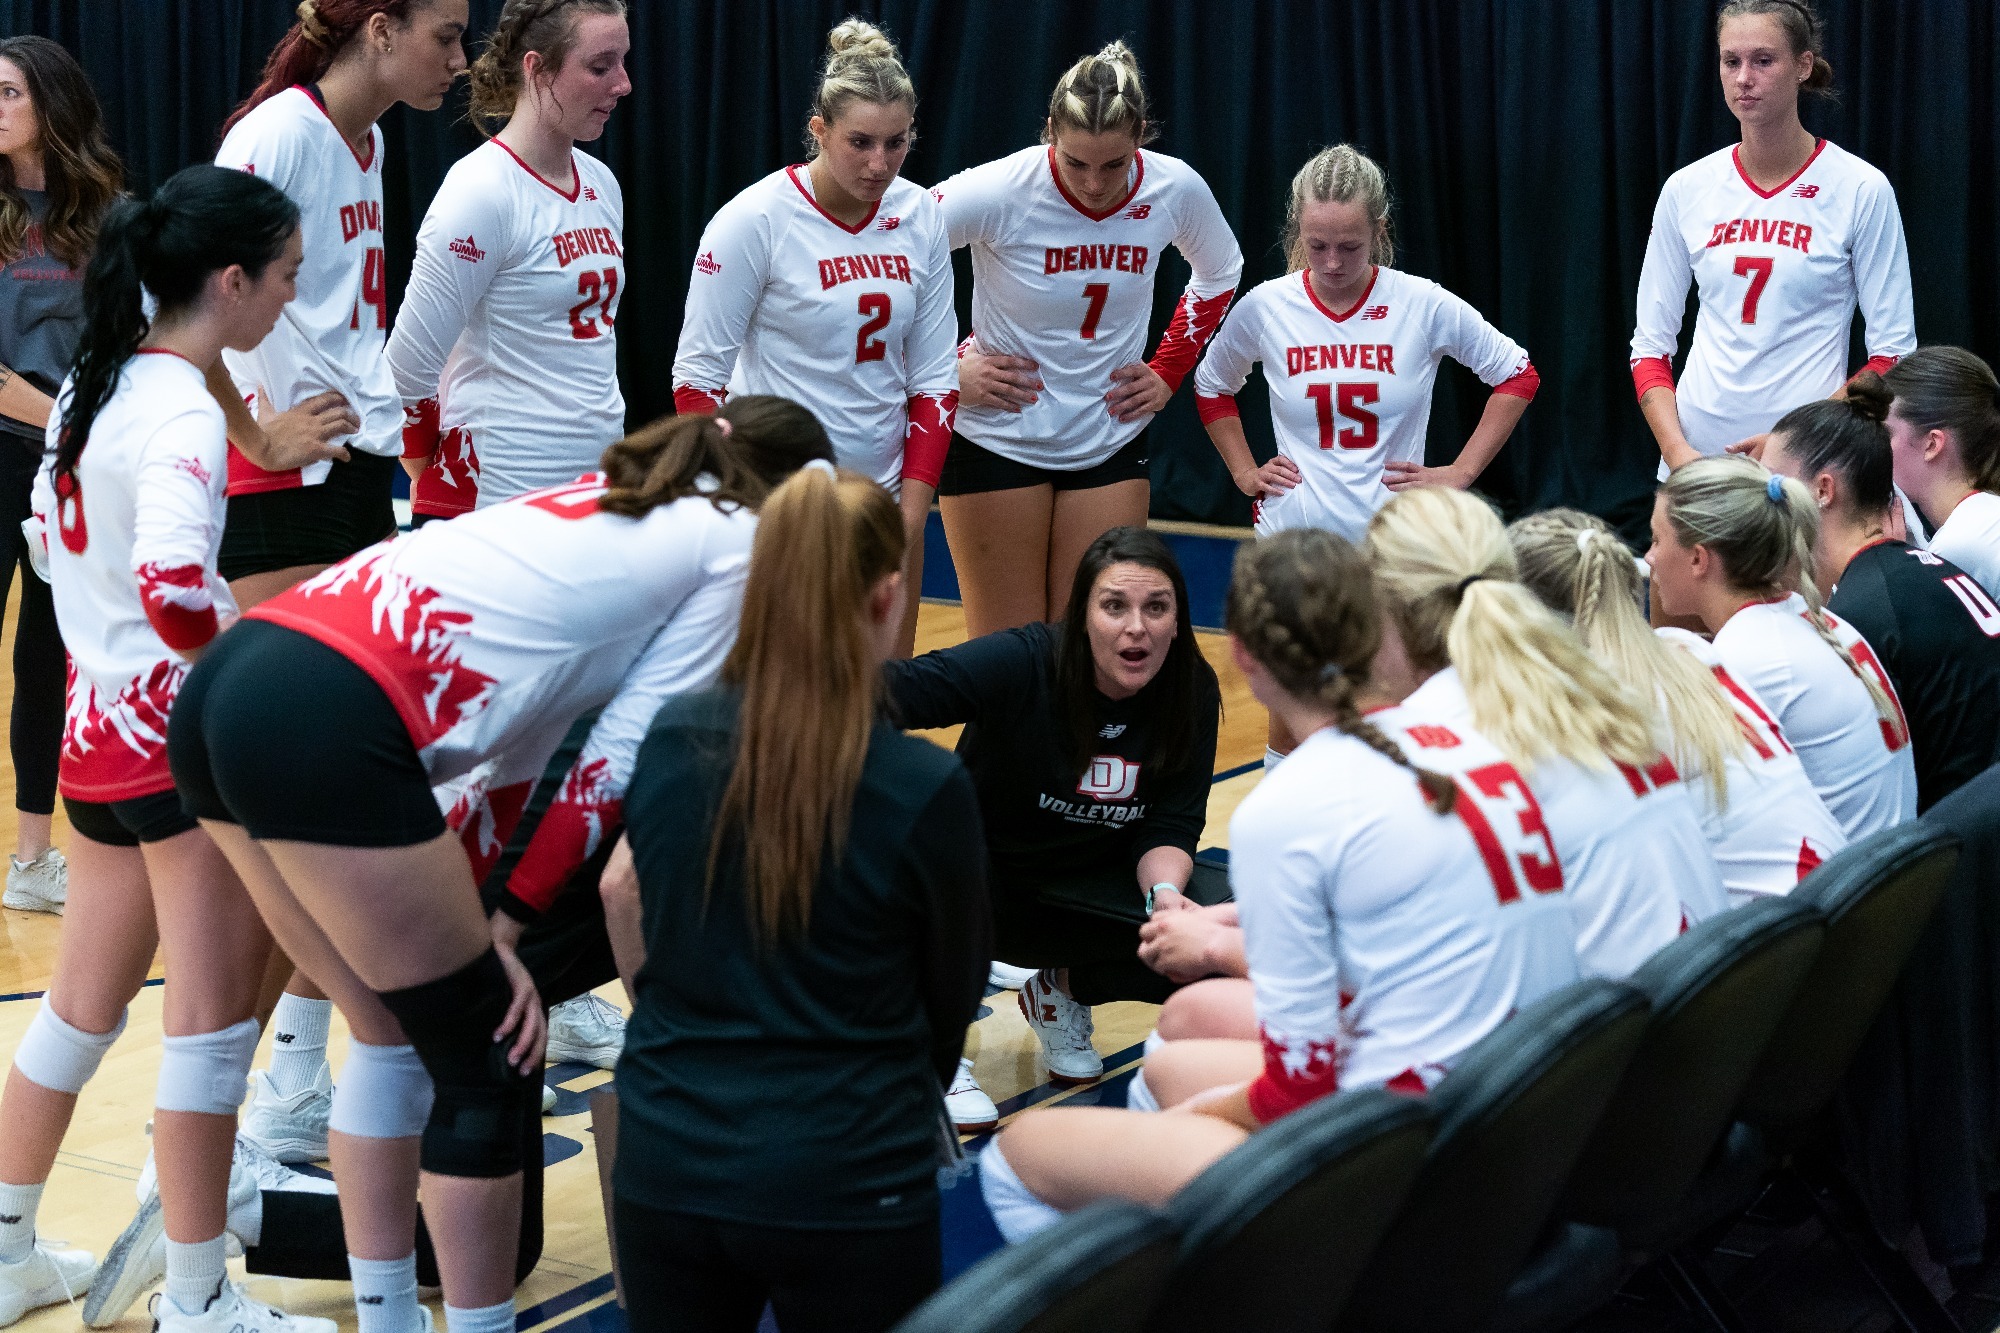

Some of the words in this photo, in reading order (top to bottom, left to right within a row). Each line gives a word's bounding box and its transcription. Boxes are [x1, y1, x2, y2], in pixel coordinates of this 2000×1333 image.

[448, 242, 486, 261] SUMMIT
[552, 226, 623, 268] DENVER
[1706, 218, 1812, 254] DENVER
[818, 253, 913, 292] DENVER
[1043, 243, 1149, 275] DENVER
[568, 266, 618, 340] 21
[1080, 282, 1110, 340] 1
[1732, 254, 1775, 326] 7
[855, 292, 893, 365] 2
[1286, 343, 1396, 378] DENVER
[1305, 381, 1380, 450] 15
[1076, 754, 1142, 802] DU
[1038, 792, 1147, 823] VOLLEYBAL
[1417, 761, 1564, 906] 13
